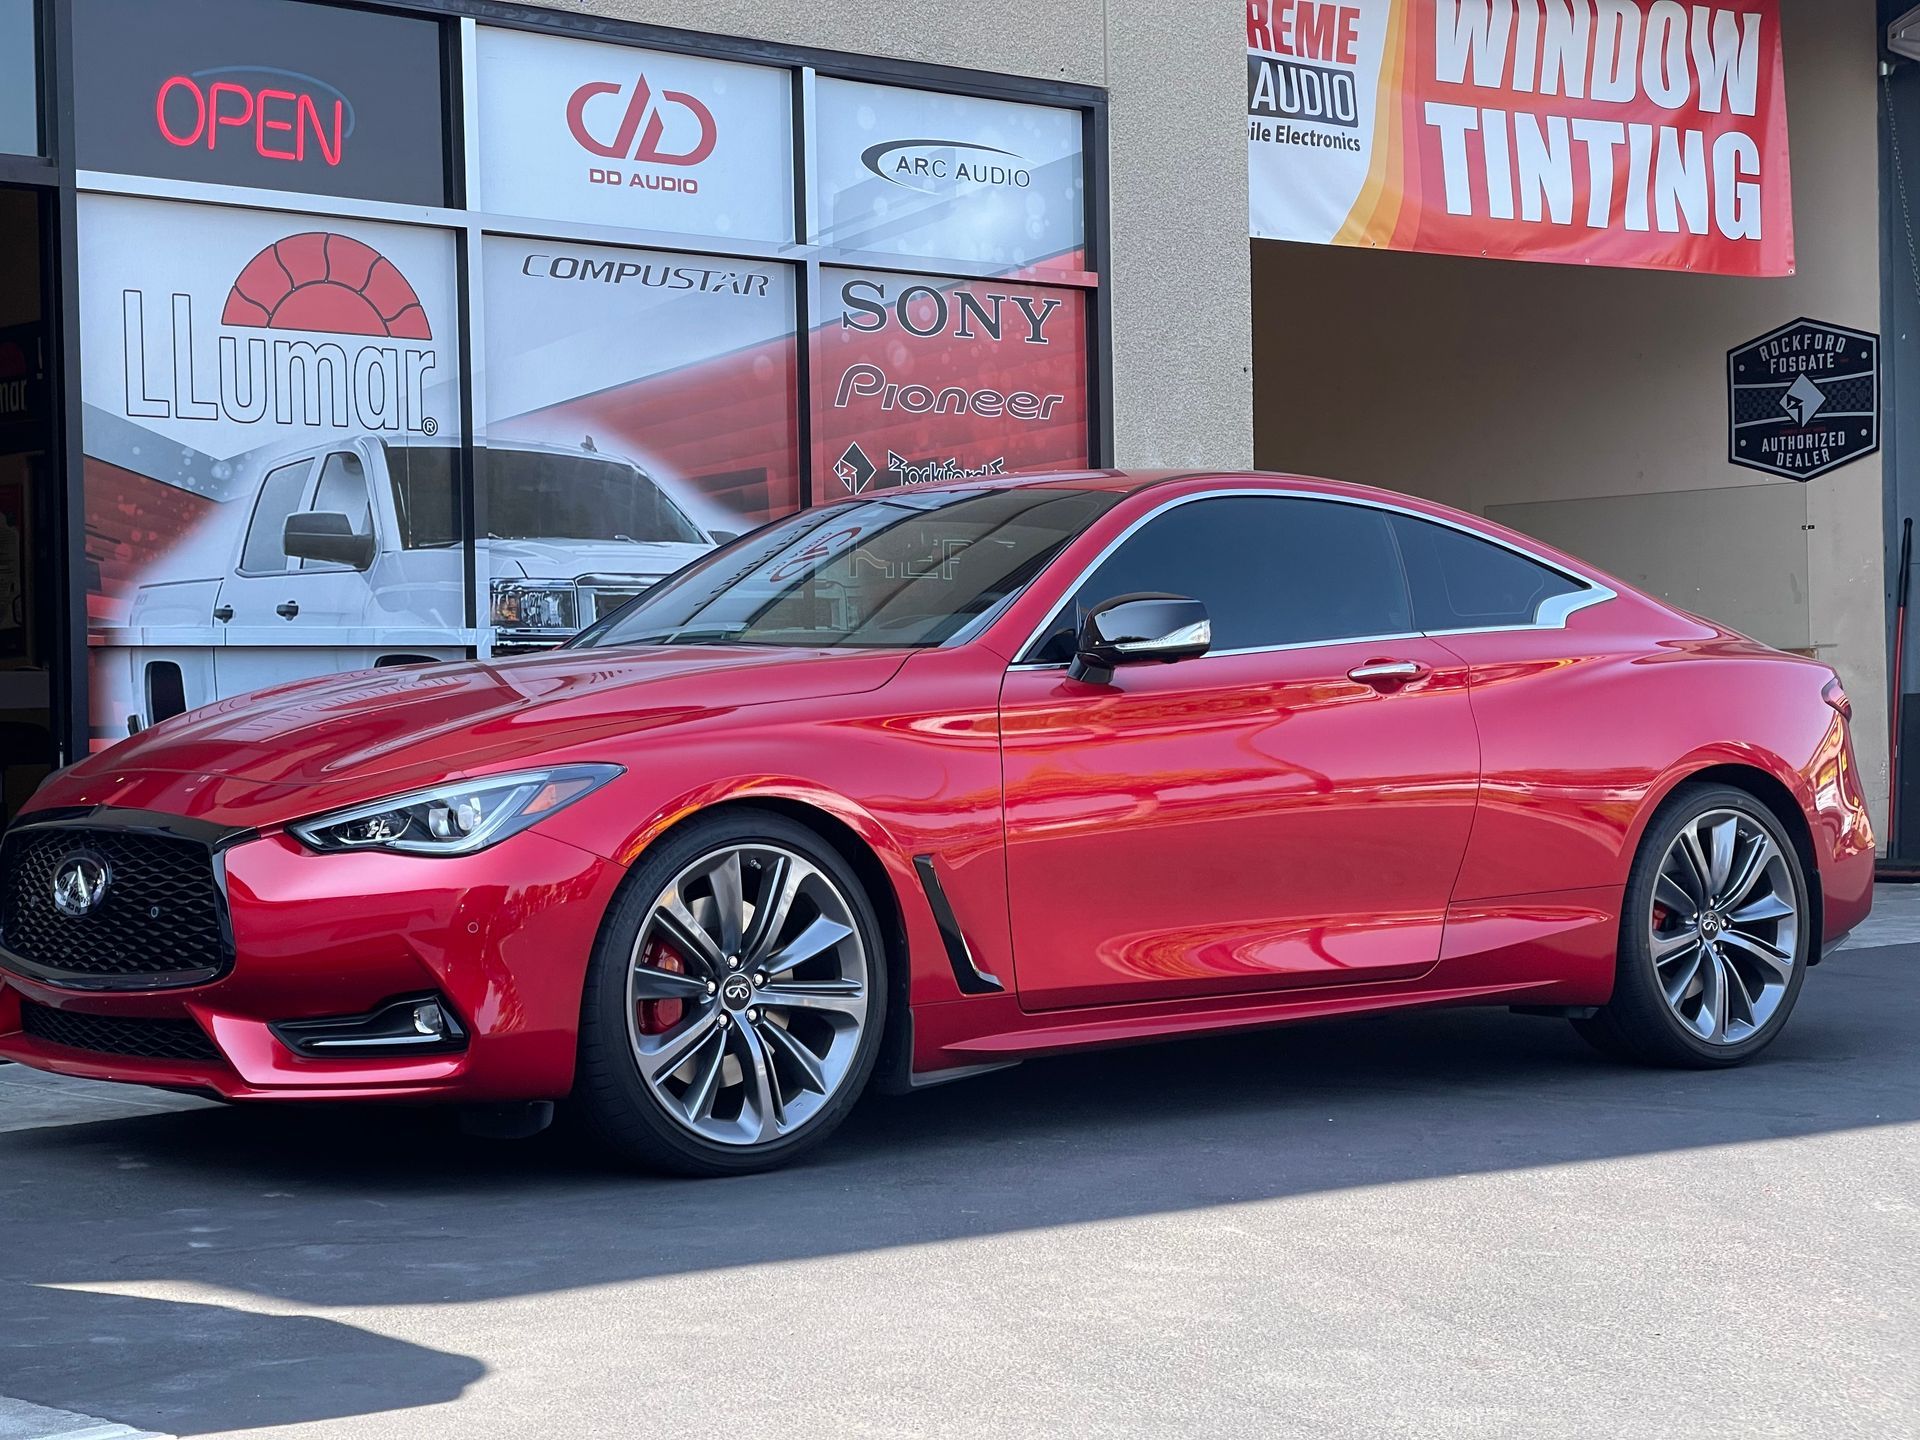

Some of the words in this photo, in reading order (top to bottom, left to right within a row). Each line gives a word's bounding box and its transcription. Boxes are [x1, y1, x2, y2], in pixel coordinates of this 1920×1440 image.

[1435, 0, 1762, 117] WINDOW
[1250, 61, 1357, 122] AUDIO
[156, 76, 343, 165] OPEN
[1247, 121, 1271, 142] ile
[1275, 124, 1361, 152] Electronics
[589, 168, 622, 186] DD
[629, 173, 698, 194] AUDIO
[896, 155, 947, 178] ARC
[955, 162, 1031, 188] AUDIO
[1424, 101, 1763, 241] TINTING
[522, 253, 770, 297] COMPUSTAR
[840, 279, 1061, 345] SONY
[1759, 334, 1846, 361] ROCKFORD
[1770, 353, 1834, 374] FOSGATE
[834, 363, 1064, 420] Pioneer
[1761, 430, 1846, 453] AUTHORIZED
[1776, 448, 1831, 468] DEALER
